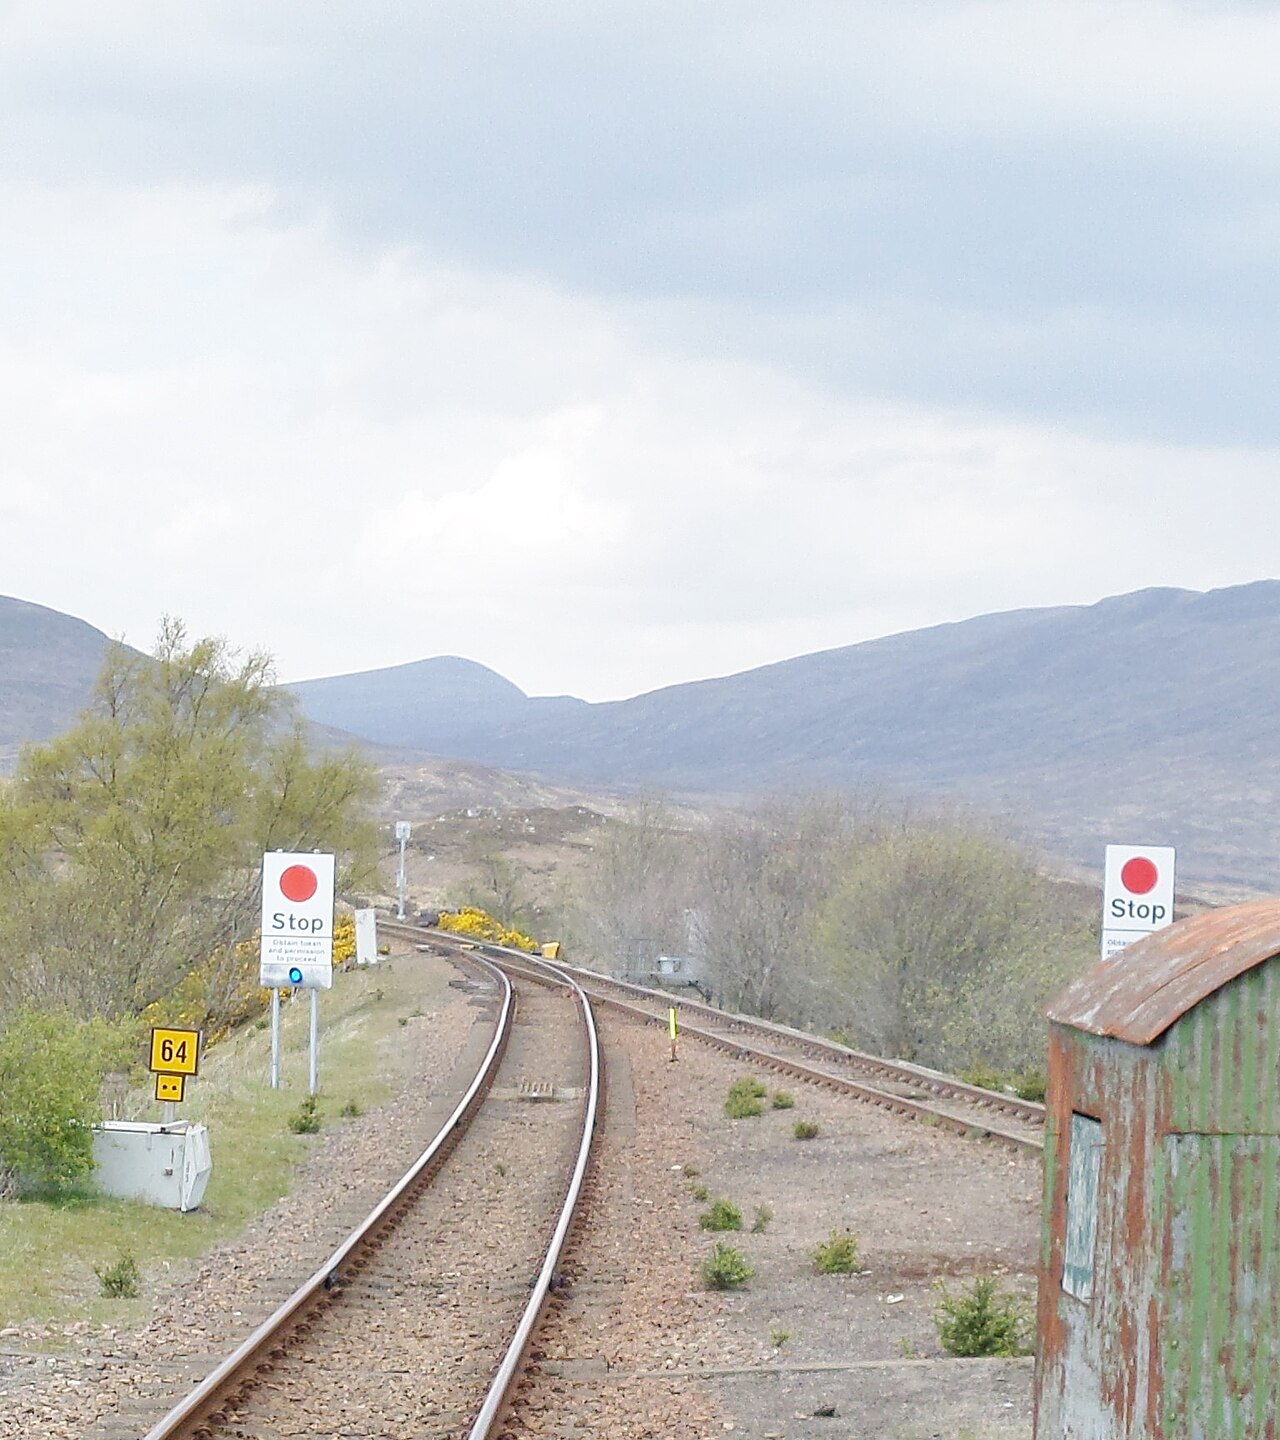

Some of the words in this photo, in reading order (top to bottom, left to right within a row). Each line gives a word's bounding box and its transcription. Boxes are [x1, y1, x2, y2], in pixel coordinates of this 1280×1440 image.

[272, 913, 323, 933] Stop
[1111, 898, 1166, 925] Stop
[161, 1039, 187, 1063] 64
